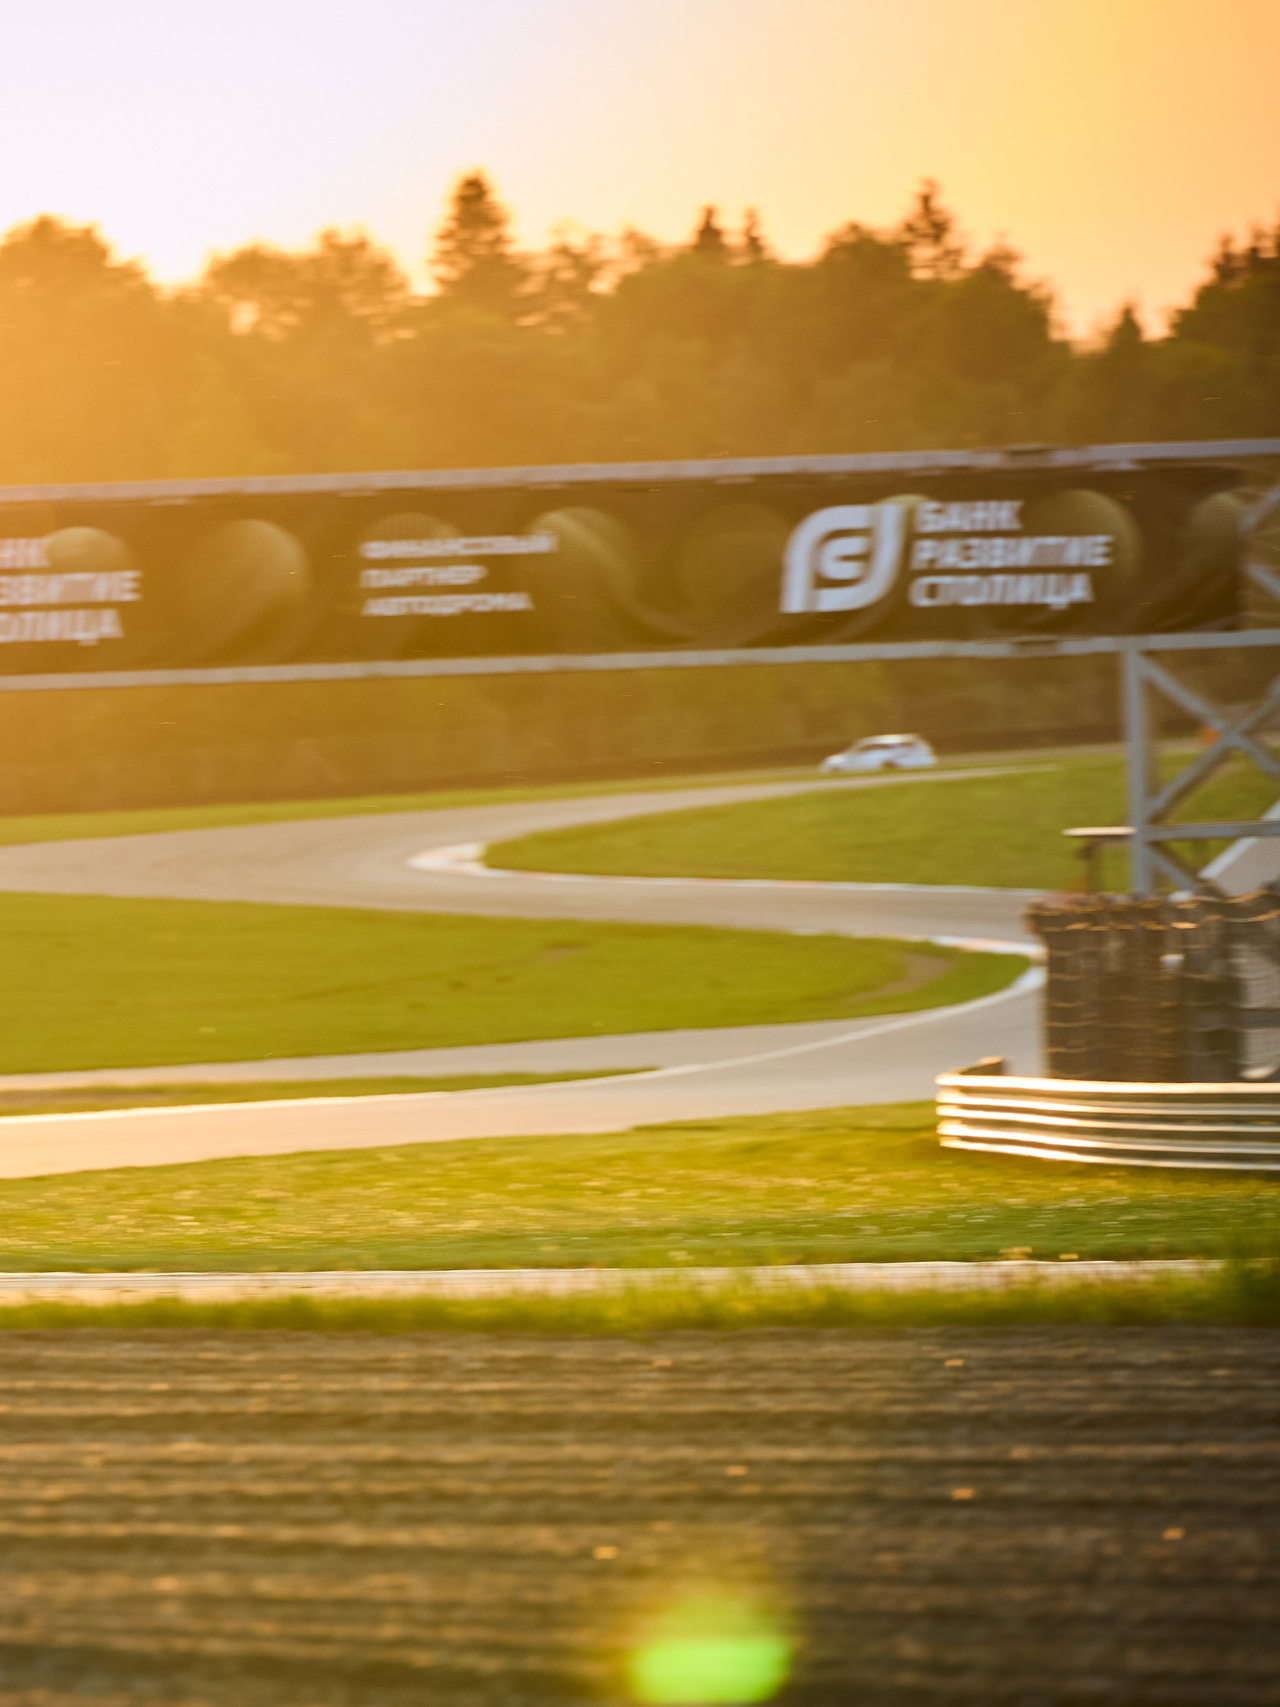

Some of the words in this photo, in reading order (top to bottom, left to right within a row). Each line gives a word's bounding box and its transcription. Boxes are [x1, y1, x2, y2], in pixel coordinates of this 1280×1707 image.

[914, 499, 1024, 533] БАНК
[910, 535, 1114, 570] РАЗВИТИЕ
[908, 573, 1095, 610] СТОЛИЦА
